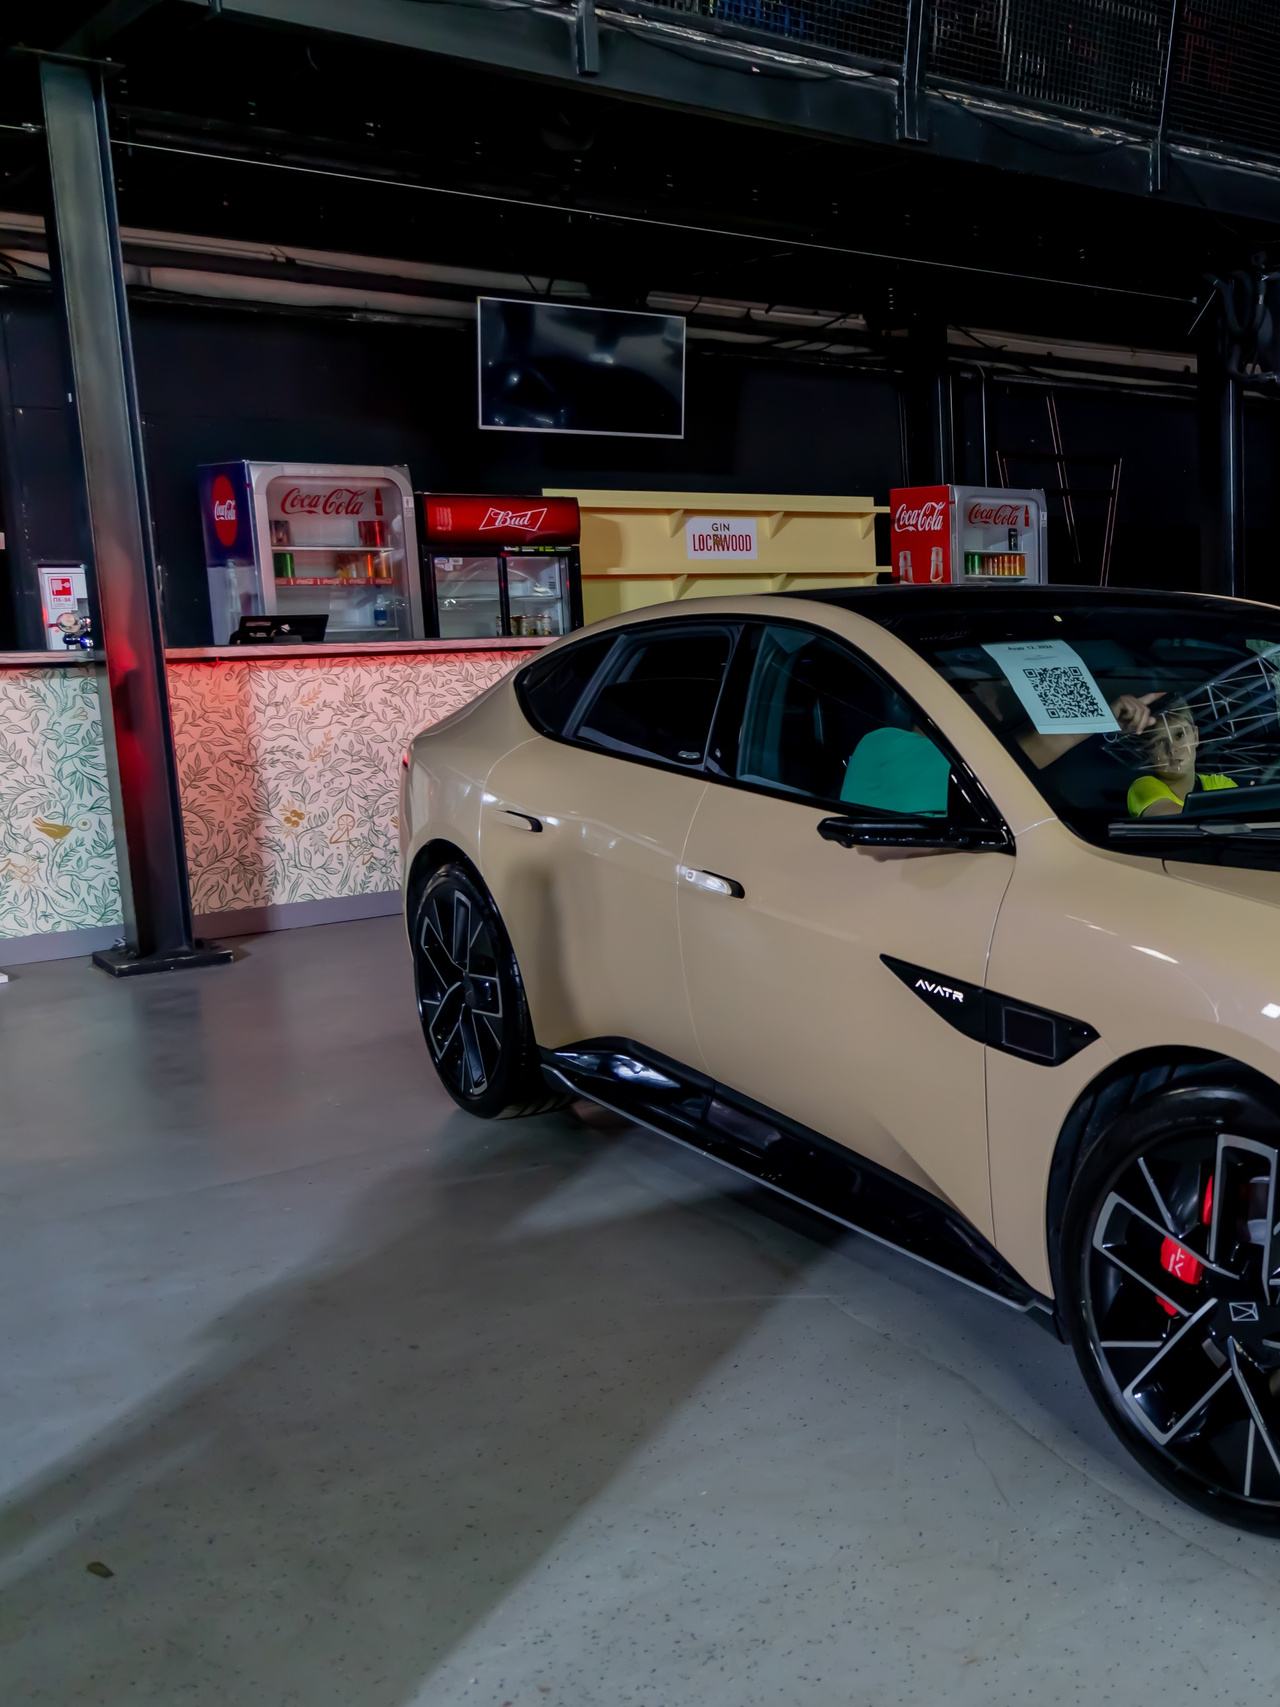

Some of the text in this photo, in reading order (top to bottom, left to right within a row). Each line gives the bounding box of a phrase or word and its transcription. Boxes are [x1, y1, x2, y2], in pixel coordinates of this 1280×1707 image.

[280, 487, 367, 515] Coca-Cola
[491, 510, 531, 527] Bud
[894, 501, 946, 533] Coca-Cola
[968, 503, 1021, 526] Coca-Cola
[711, 522, 730, 532] GIN
[914, 978, 965, 1004] AVATR
